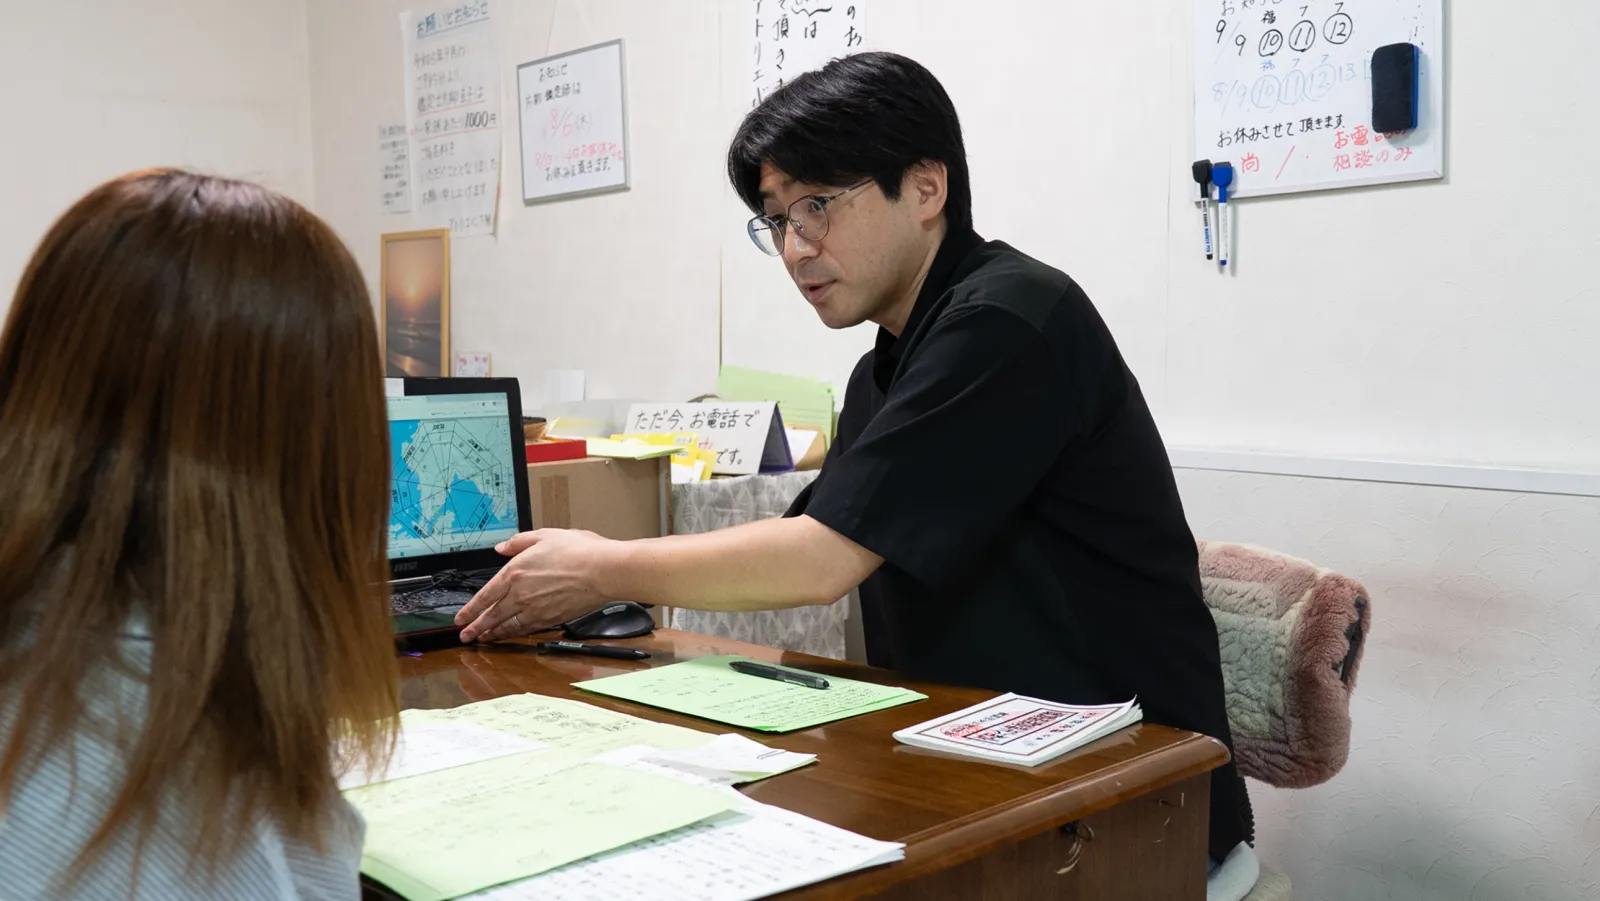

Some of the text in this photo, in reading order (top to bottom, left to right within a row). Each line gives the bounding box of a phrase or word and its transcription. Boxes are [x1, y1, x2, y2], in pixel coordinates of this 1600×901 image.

[804, 20, 817, 39] は
[1240, 151, 1260, 173] 尚
[1333, 147, 1412, 172] 相談のみ
[716, 448, 743, 465] です。
